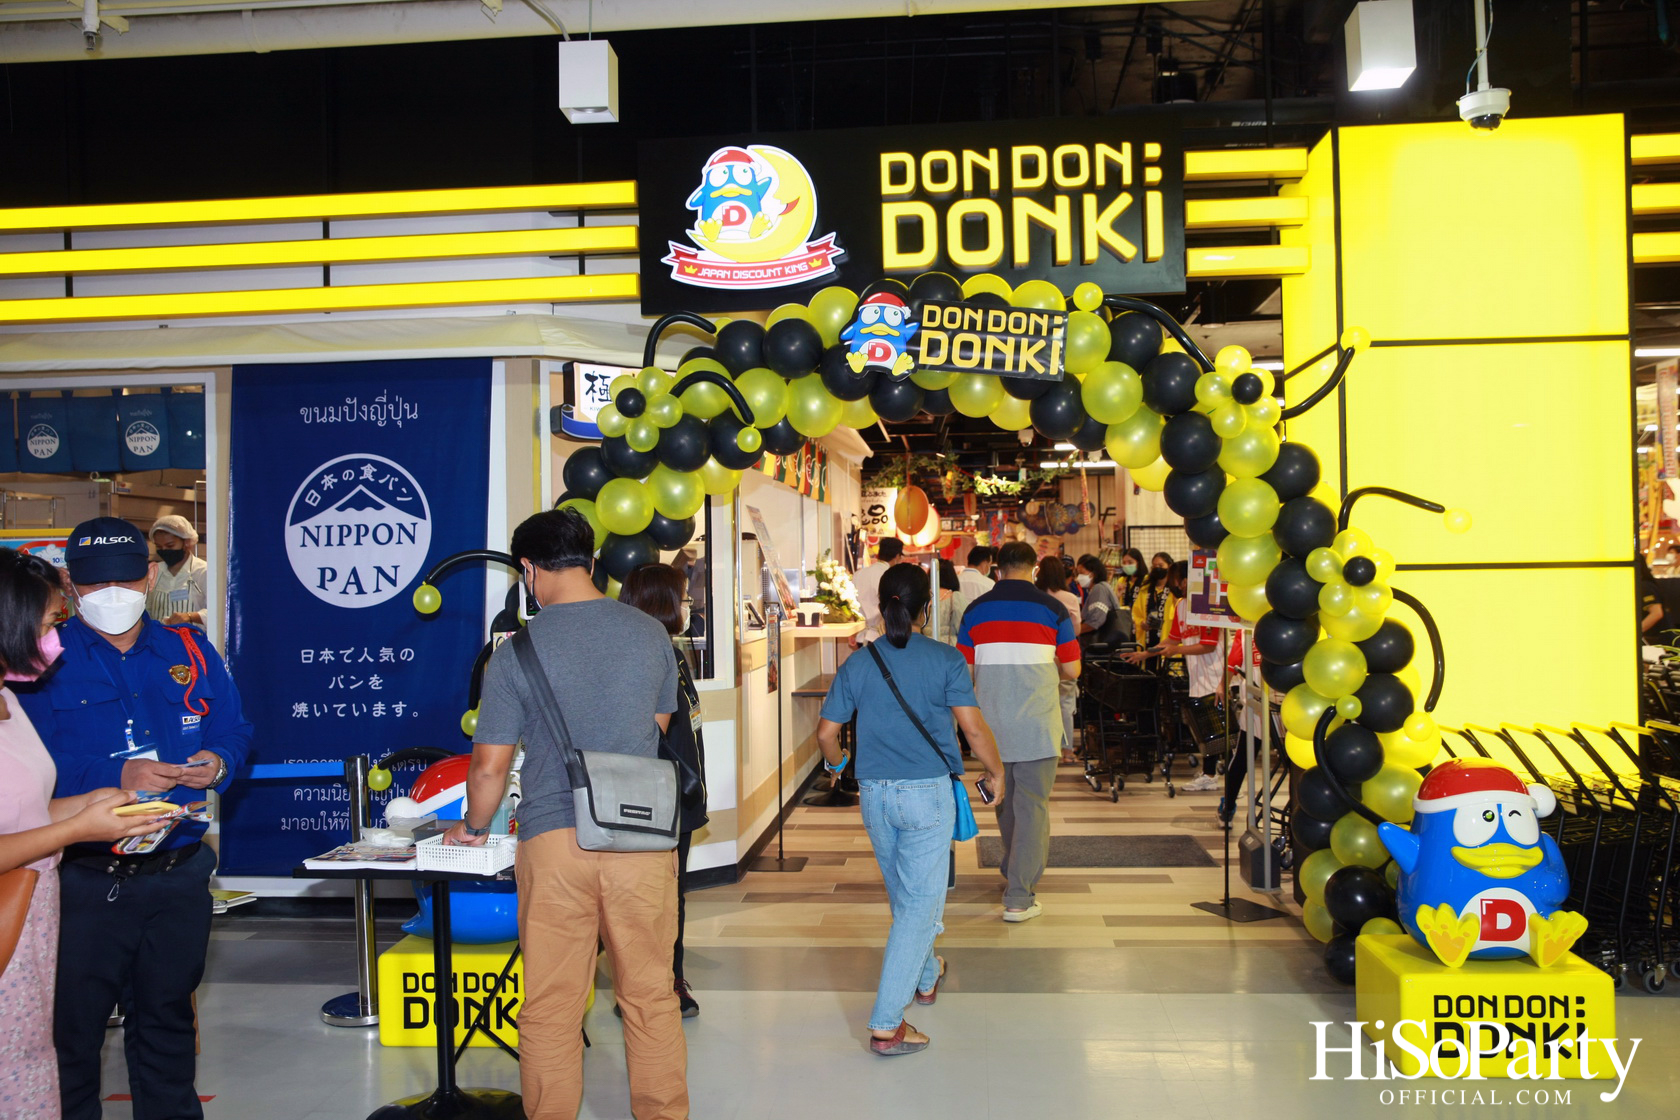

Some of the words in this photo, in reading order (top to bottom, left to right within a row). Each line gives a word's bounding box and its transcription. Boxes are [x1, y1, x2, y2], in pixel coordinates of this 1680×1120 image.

[880, 148, 999, 197] DON
[722, 205, 747, 227] D
[881, 191, 1164, 270] DONKI
[697, 267, 731, 280] JAPAN
[732, 267, 783, 280] DISCOUNT
[784, 262, 809, 276] KING
[921, 304, 983, 331] DON
[867, 341, 892, 363] D
[918, 330, 1062, 376] DONKI
[299, 389, 419, 429] ขนมปังญี่ปุ่น
[30, 438, 56, 446] NIPPON
[129, 435, 157, 443] NIPPON
[133, 445, 154, 453] PAN
[34, 448, 53, 456] PAN
[305, 463, 413, 507] 日本の食パン
[93, 536, 136, 545] ALSOK
[299, 522, 419, 548] NIPPON
[316, 565, 401, 596] PAN
[300, 647, 415, 664] 日本で人気の
[328, 674, 383, 690] パンを
[291, 701, 419, 718] 焼いています。
[1480, 898, 1527, 942] D
[1433, 995, 1498, 1018] DON
